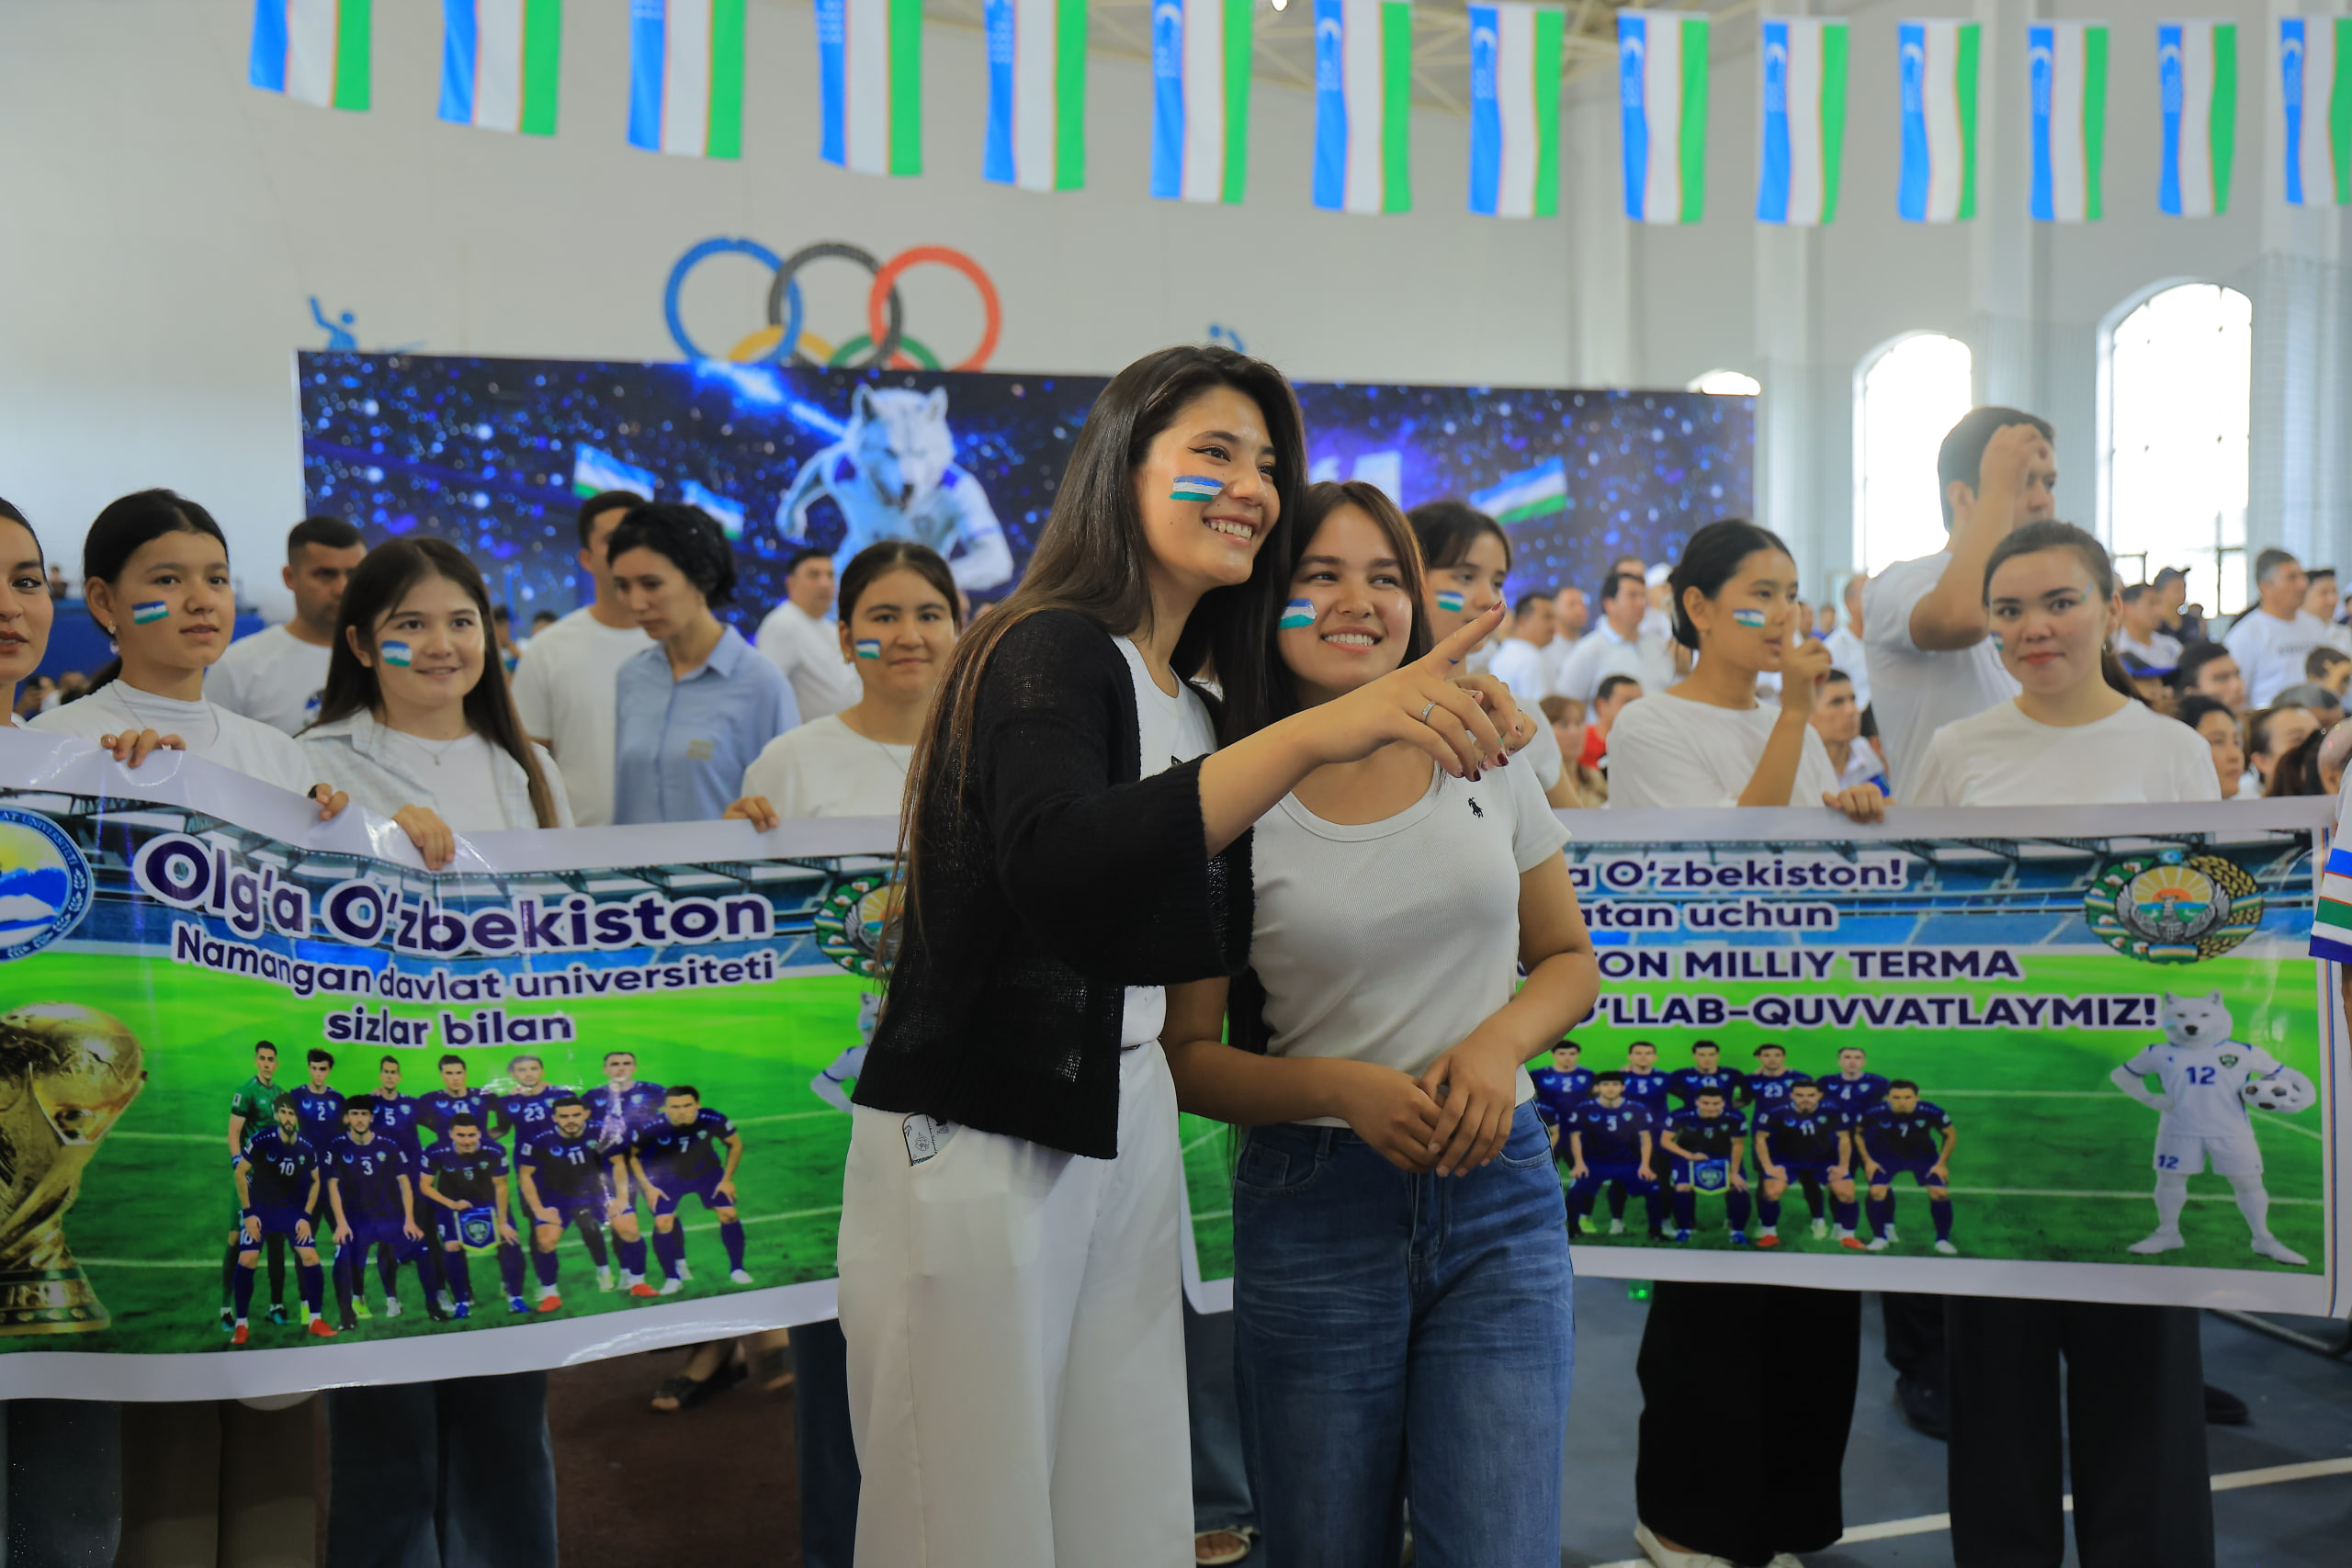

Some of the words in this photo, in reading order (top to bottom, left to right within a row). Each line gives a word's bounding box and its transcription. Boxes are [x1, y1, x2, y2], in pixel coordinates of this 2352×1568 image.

[1606, 859, 1901, 887] O'zbekiston!
[145, 840, 303, 932] Olg'a
[330, 885, 766, 952] O'zbekiston
[1690, 900, 1833, 927] uchun
[177, 925, 370, 996] Namangan
[379, 966, 501, 1000] davlat
[515, 953, 773, 998] universiteti
[1686, 951, 1835, 978] MILLIY
[1849, 950, 2019, 977] TERMA
[328, 1006, 429, 1045] sizlar
[443, 1010, 572, 1045] bilan
[2186, 1066, 2216, 1085] 12
[1764, 1085, 1783, 1099] 23
[1840, 1087, 1851, 1100] 4
[317, 1105, 326, 1122] 2
[524, 1106, 546, 1122] 23
[612, 1100, 623, 1116] 4
[385, 1111, 395, 1126] 5
[1607, 1118, 1617, 1132] 3
[1800, 1123, 1815, 1137] 11
[679, 1140, 689, 1153] 7
[567, 1149, 586, 1166] 11
[2157, 1154, 2179, 1169] 12
[279, 1161, 295, 1176] 10
[362, 1159, 373, 1176] 3
